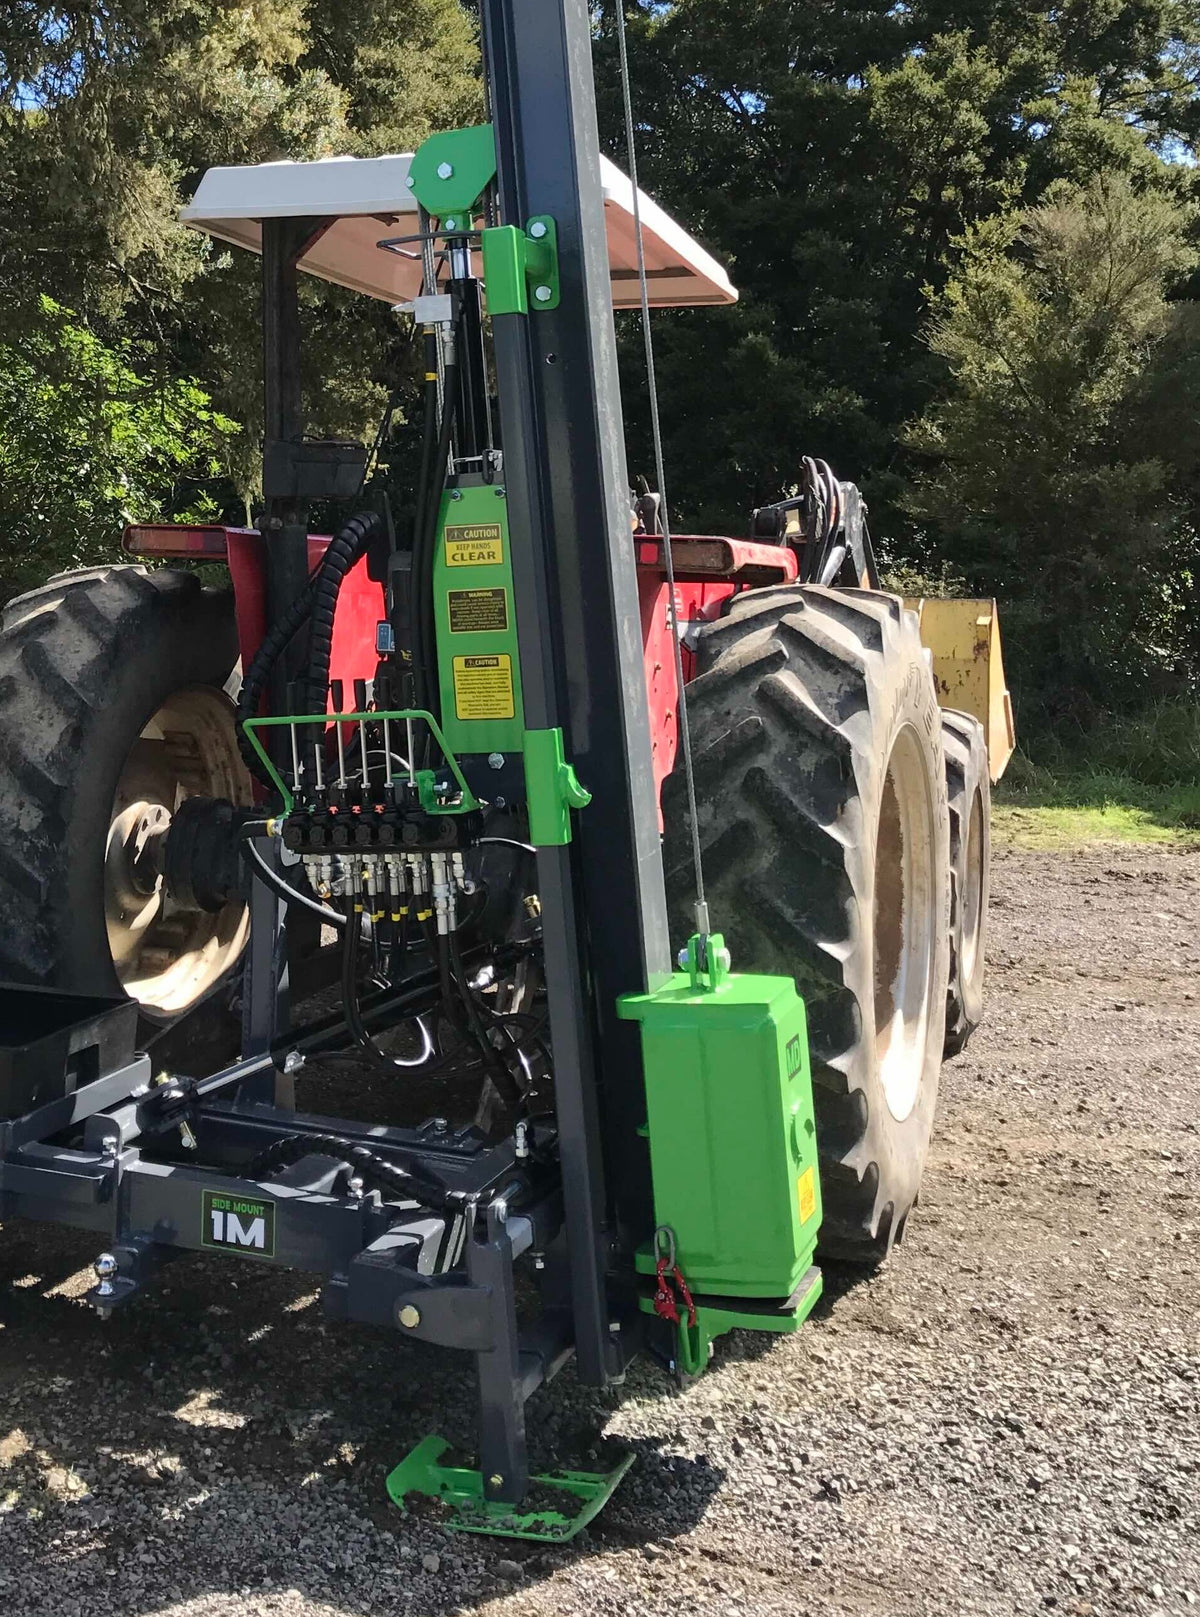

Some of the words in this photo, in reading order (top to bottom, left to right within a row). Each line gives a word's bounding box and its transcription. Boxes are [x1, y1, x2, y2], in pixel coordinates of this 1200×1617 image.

[463, 528, 497, 539] CAUTION
[456, 543, 470, 551] KEEP
[471, 542, 491, 550] HANDS
[451, 551, 496, 562] CLEAR
[211, 1198, 231, 1211] SIDE
[233, 1202, 265, 1216] MOUNT
[211, 1210, 265, 1249] 1M
